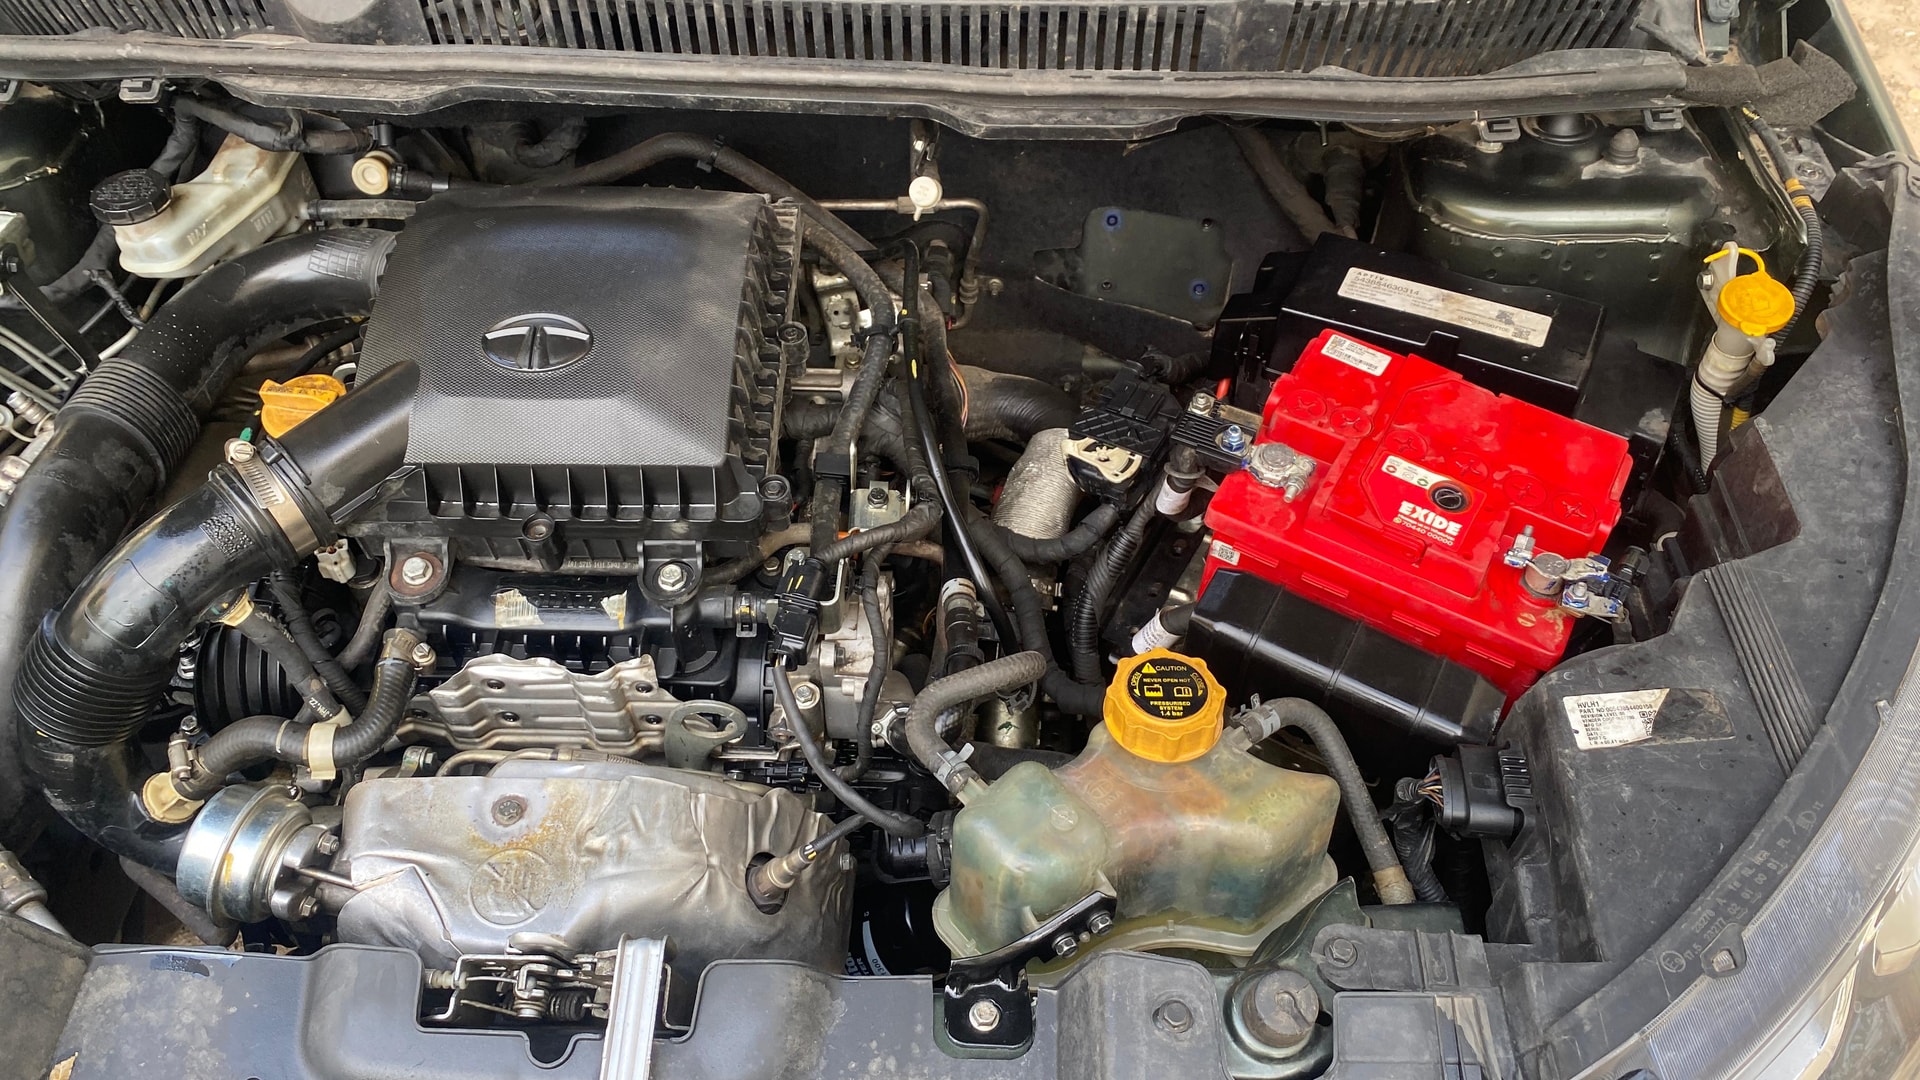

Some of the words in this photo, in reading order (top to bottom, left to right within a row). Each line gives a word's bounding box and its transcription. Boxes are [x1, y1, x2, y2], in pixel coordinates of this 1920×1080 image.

[186, 222, 208, 246] MAX
[1356, 271, 1385, 281] APTIV
[1399, 501, 1462, 536] EXIDE
[1402, 520, 1426, 534] 70440
[1427, 530, 1454, 546] 00000
[1131, 672, 1142, 687] OPEN
[1190, 672, 1205, 691] CLOSE
